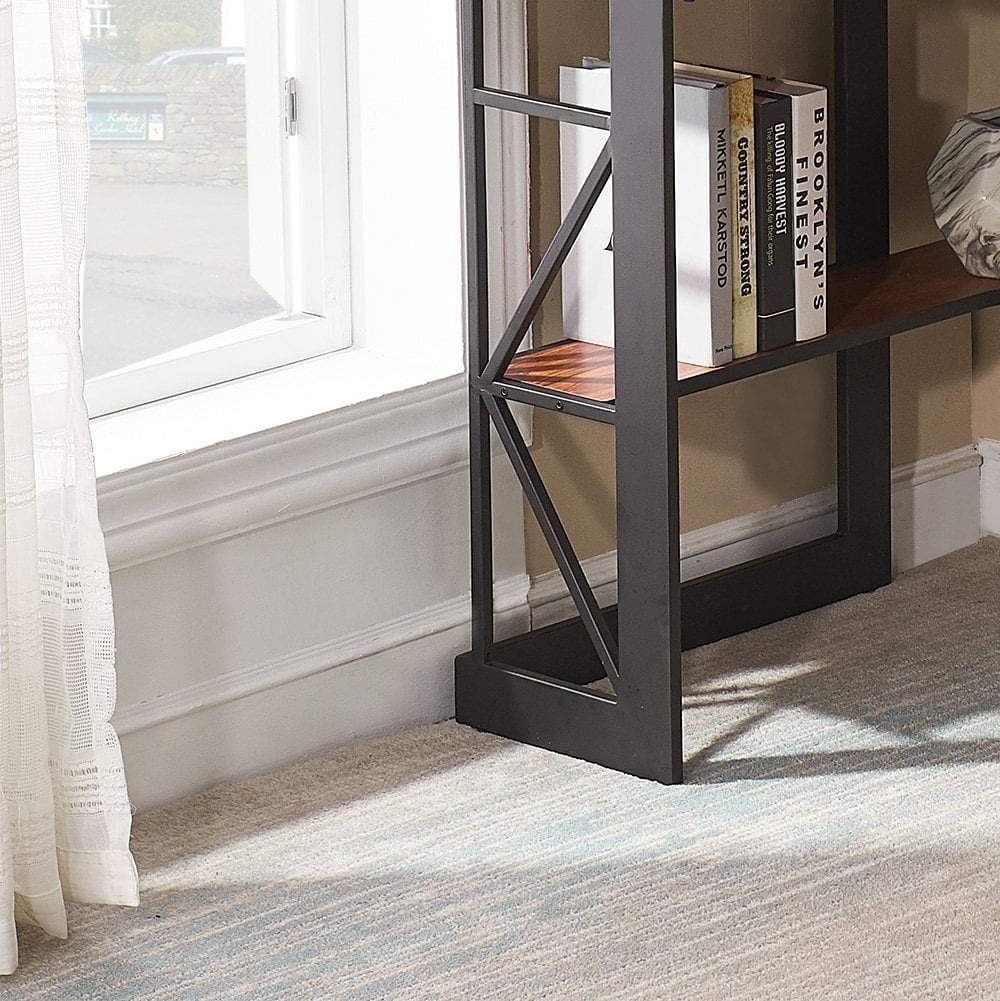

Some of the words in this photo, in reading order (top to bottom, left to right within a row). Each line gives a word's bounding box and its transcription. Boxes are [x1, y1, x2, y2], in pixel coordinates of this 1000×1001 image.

[717, 128, 727, 202] MIKKETL
[737, 136, 749, 221] COUNTRY
[774, 122, 786, 173] BLOODY
[775, 177, 787, 235] HARVEST
[796, 156, 808, 269] FINEST
[814, 107, 825, 310] BROOKLYN'S
[717, 208, 728, 288] KARSTOD
[739, 225, 752, 296] STRONG
